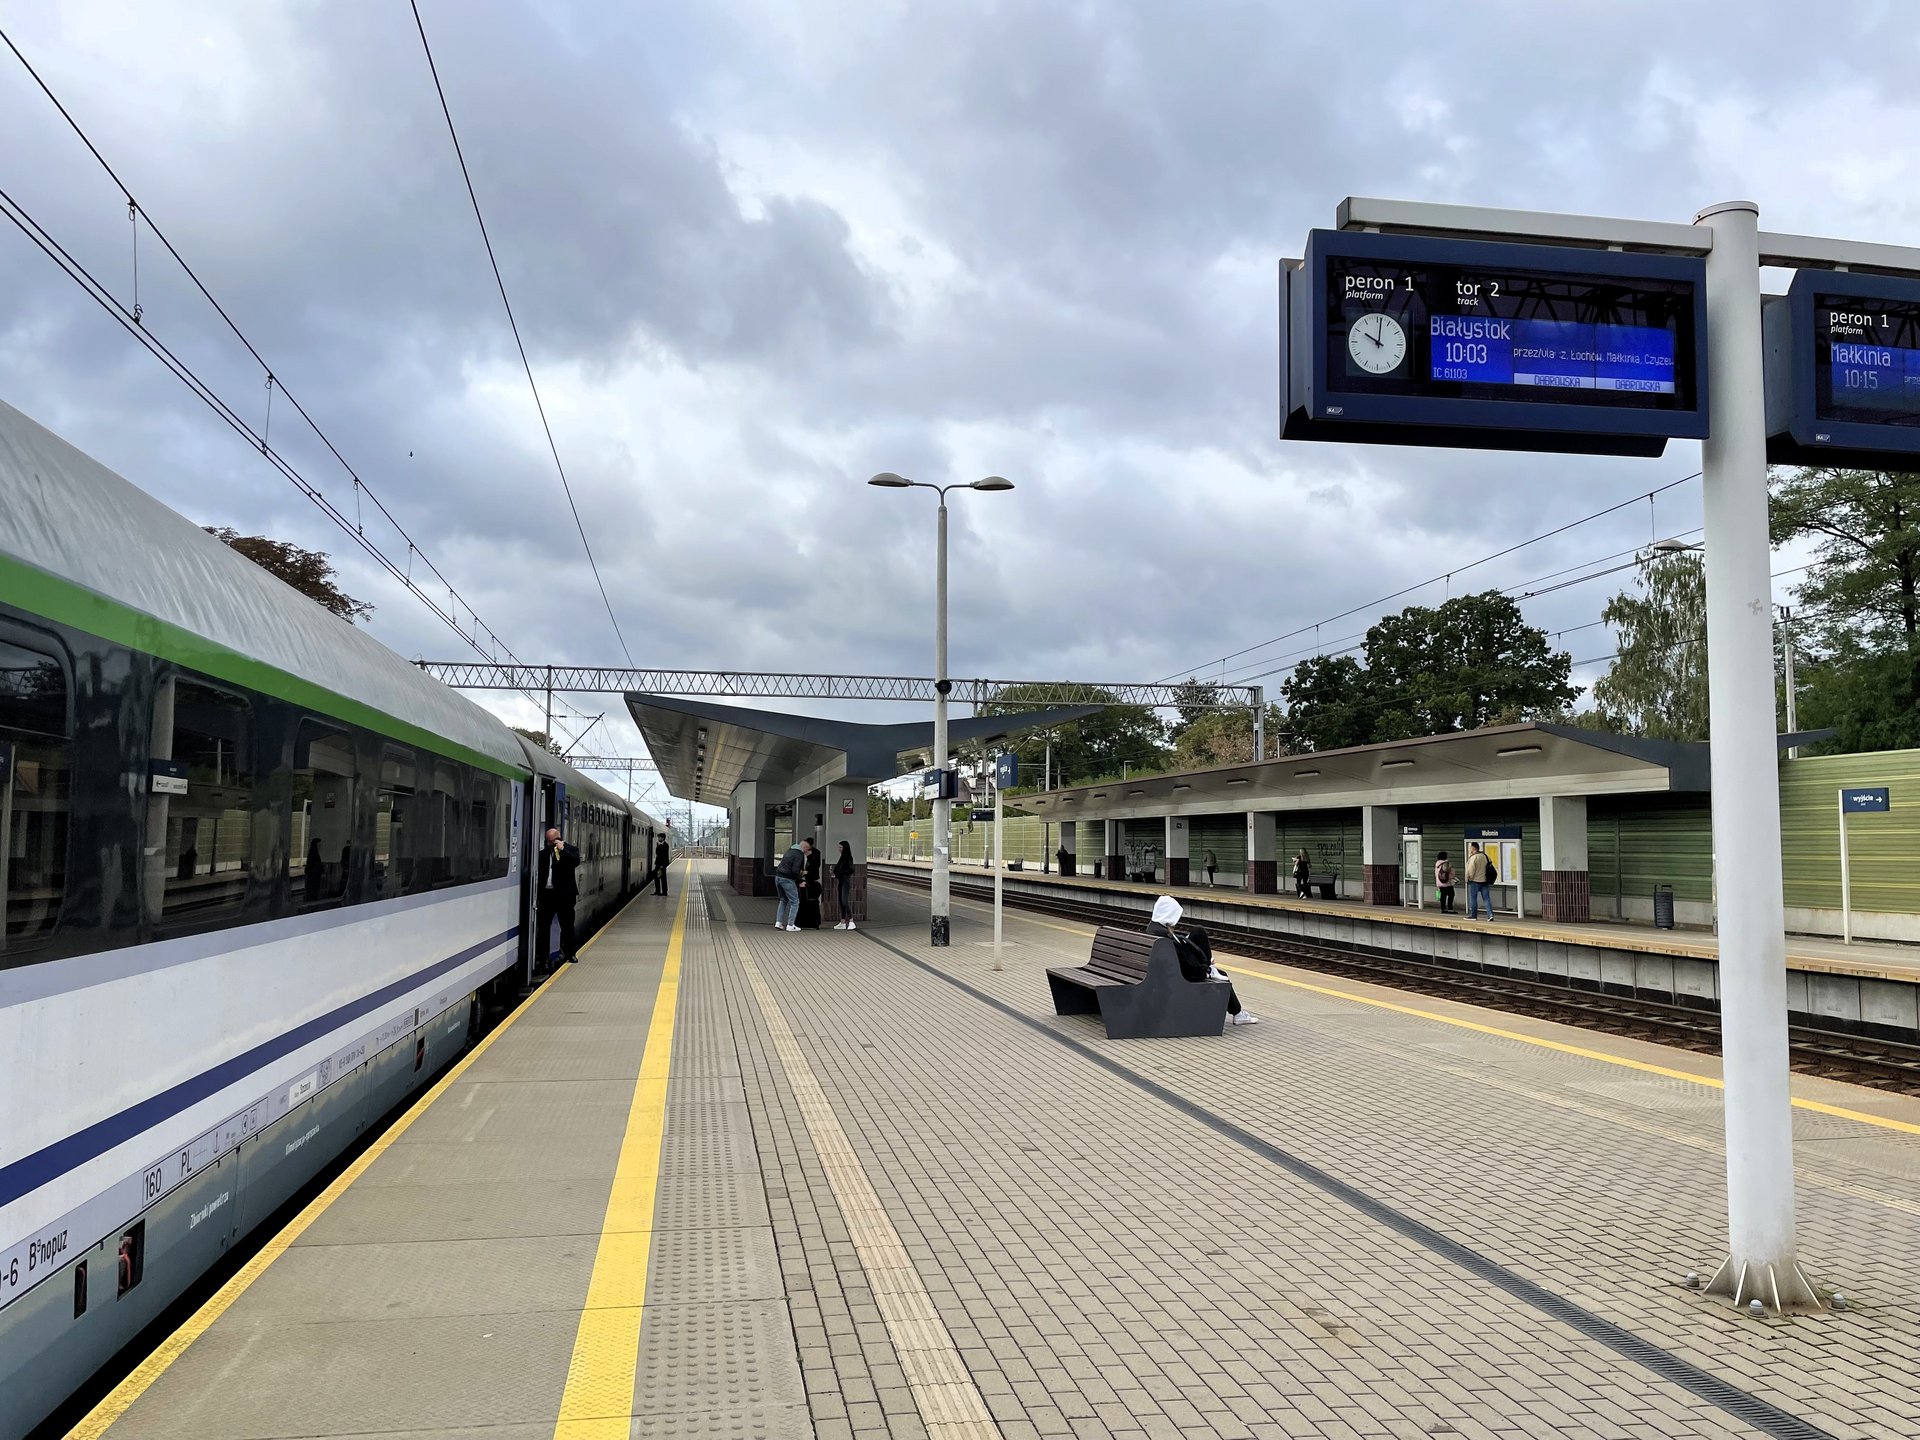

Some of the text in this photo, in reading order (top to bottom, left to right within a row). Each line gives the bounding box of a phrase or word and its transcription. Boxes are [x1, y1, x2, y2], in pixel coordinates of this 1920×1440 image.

[1345, 275, 1414, 292] peron 1
[1456, 280, 1500, 297] tor 2
[1345, 289, 1384, 300] platform
[1457, 297, 1479, 306] track
[1430, 316, 1511, 340] Białystok
[1830, 311, 1890, 328] peron 1
[1830, 325, 1863, 335] platform
[1445, 342, 1487, 363] 10:03
[1831, 343, 1891, 366] Małkinia
[1433, 367, 1468, 380] IC 61103
[1844, 368, 1879, 389] 10:15
[145, 1149, 192, 1200] 160 PL
